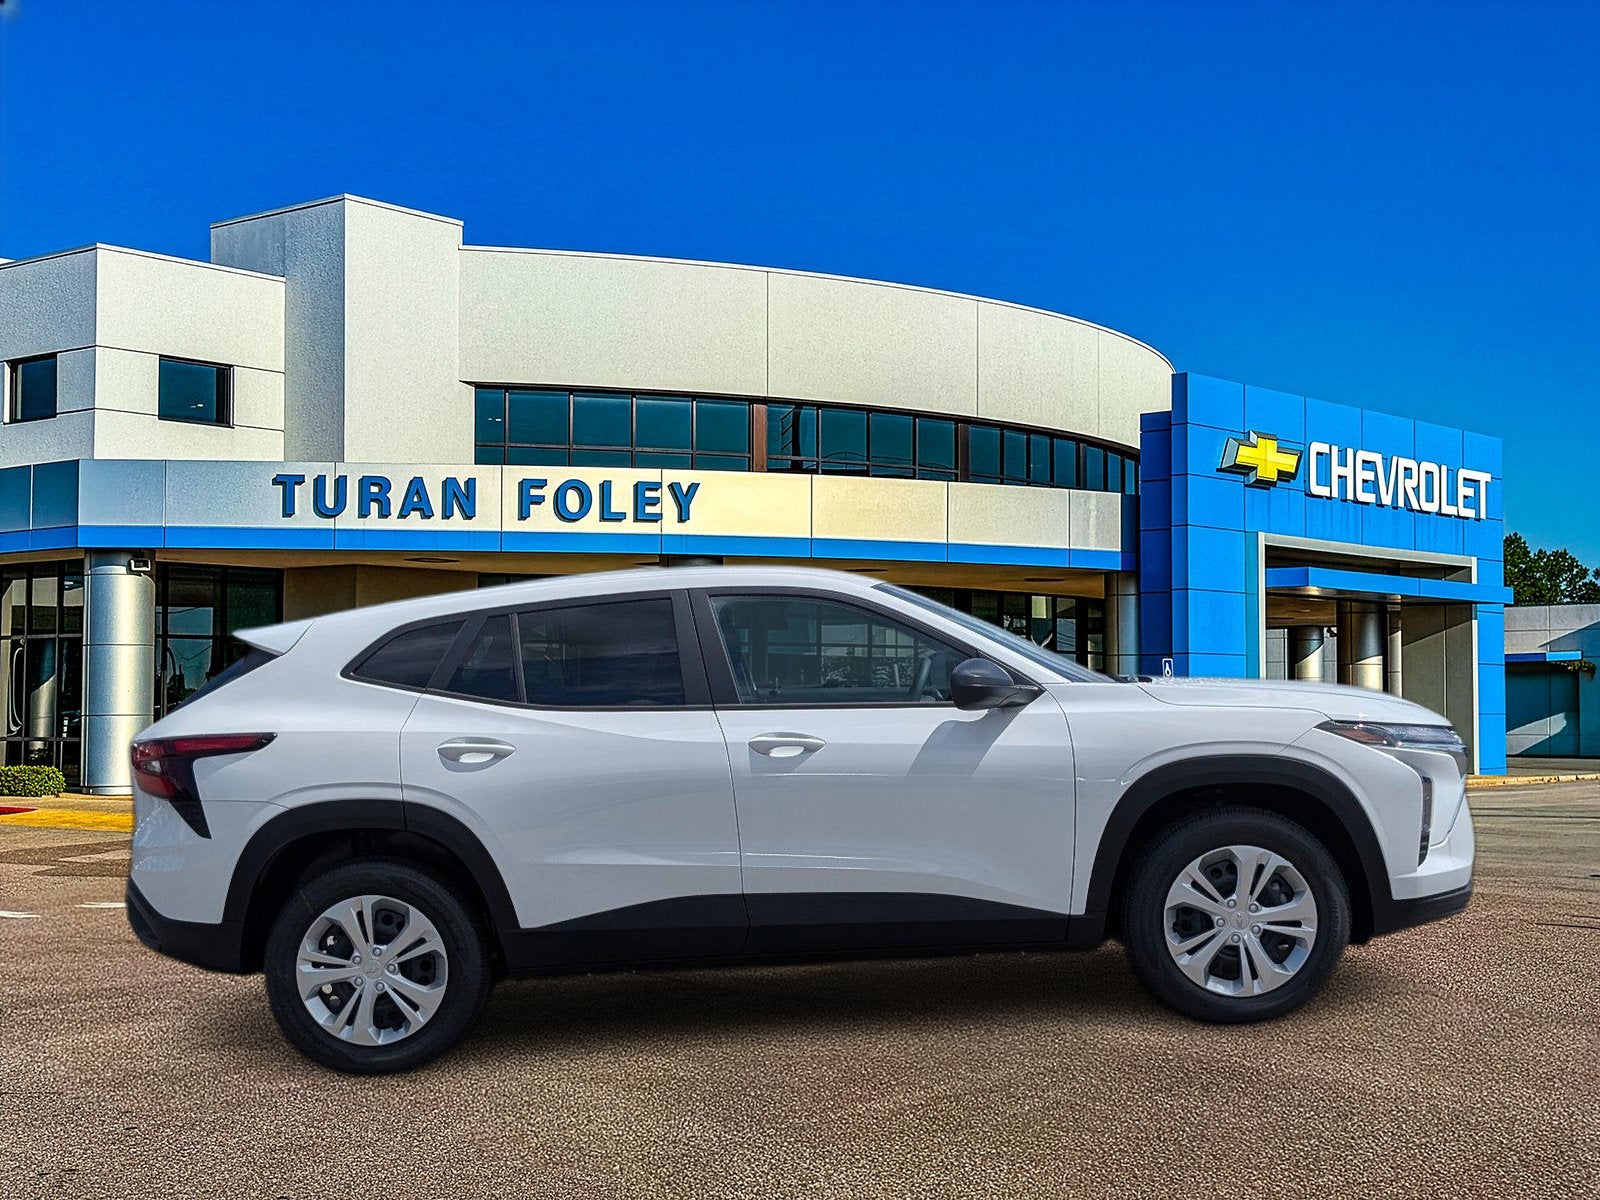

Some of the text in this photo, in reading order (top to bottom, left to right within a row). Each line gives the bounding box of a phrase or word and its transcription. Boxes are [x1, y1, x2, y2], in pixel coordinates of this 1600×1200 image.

[272, 473, 700, 523] TURAN FOLEY
[1308, 441, 1491, 520] CHEVROLET
